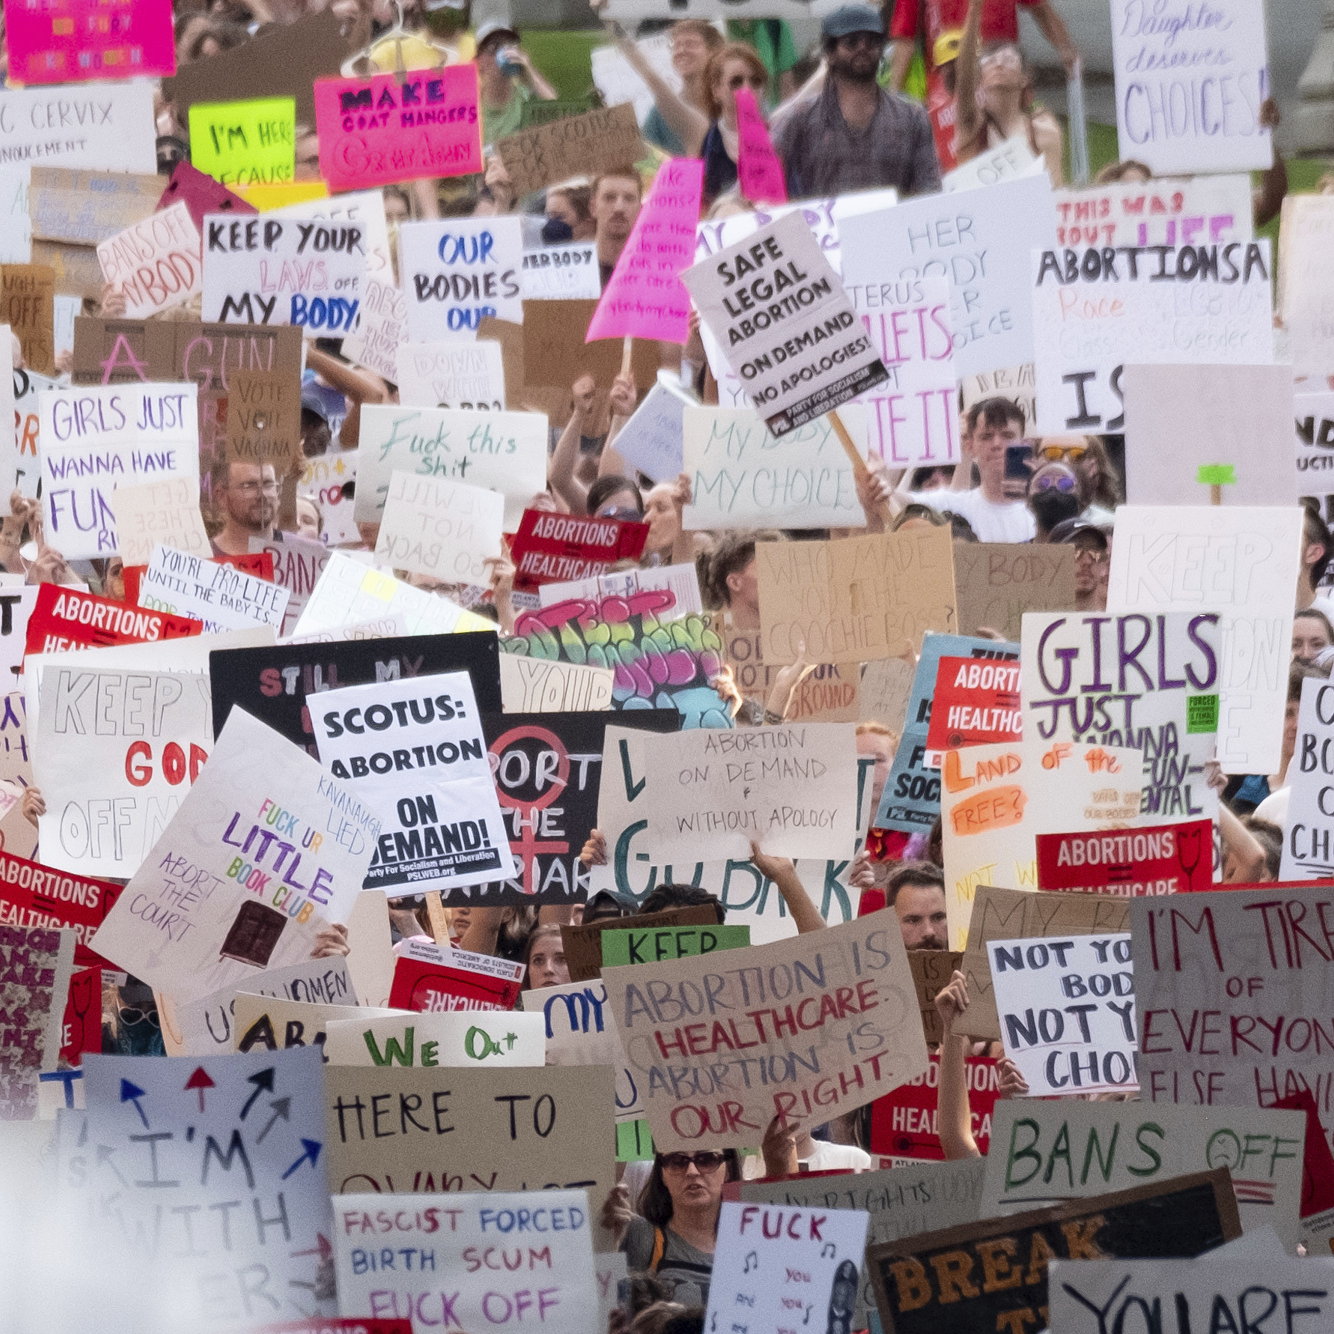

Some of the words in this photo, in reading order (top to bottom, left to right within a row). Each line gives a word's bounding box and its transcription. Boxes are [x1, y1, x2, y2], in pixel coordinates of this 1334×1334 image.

[31, 101, 113, 129] CERVIX
[1125, 68, 1270, 143] CHOICES!
[1122, 193, 1183, 215] WAS
[438, 233, 497, 263] OUR
[717, 237, 783, 286] SAFE
[415, 270, 520, 301] BODIES
[723, 261, 807, 319] LEGAL
[728, 278, 832, 346] ABORTION
[740, 355, 772, 379] ON
[772, 311, 853, 364] DEMAND
[53, 397, 126, 440] GIRLS
[136, 395, 189, 429] JUST
[752, 387, 778, 407] NO
[48, 451, 123, 485] WANNA
[133, 450, 177, 473] HAVE
[753, 469, 857, 510] CHOICE
[532, 517, 617, 547] ABORTIONS
[52, 597, 161, 641] ABORTIONS
[1037, 615, 1220, 696] GIRLS
[324, 695, 466, 738] SCOTUS:
[1030, 695, 1141, 739] JUST
[331, 738, 483, 779] ABORTION
[705, 730, 804, 755] ABORTION
[679, 767, 709, 784] ON
[726, 762, 826, 784] DEMAND
[944, 751, 1021, 793] LAND
[258, 798, 298, 837] FUCK
[397, 795, 438, 827] ON
[676, 811, 758, 832] WITHOUT
[769, 809, 837, 830] APOLOGY
[951, 789, 1027, 832] FREE?
[222, 812, 334, 906] LITTLE
[1057, 830, 1175, 866] ABORTIONS
[227, 857, 267, 897] BOOK
[273, 884, 314, 924] CLUB
[994, 942, 1074, 973] NOT
[1147, 906, 1224, 972] I'M
[624, 955, 826, 1027] ABORTION
[853, 931, 890, 974] IS
[1226, 977, 1264, 998] OF
[1005, 1005, 1097, 1049] NOT
[333, 1093, 454, 1142] HERE
[495, 1094, 556, 1140] TO
[670, 1101, 760, 1139] OUR
[1005, 1118, 1165, 1194] BANS
[345, 1209, 463, 1236] FASCIST
[479, 1208, 584, 1231] FORCED
[741, 1207, 828, 1241] FUCK
[352, 1250, 436, 1274] BIRTH
[462, 1247, 552, 1271] SCUM
[482, 1288, 560, 1324] OFF
